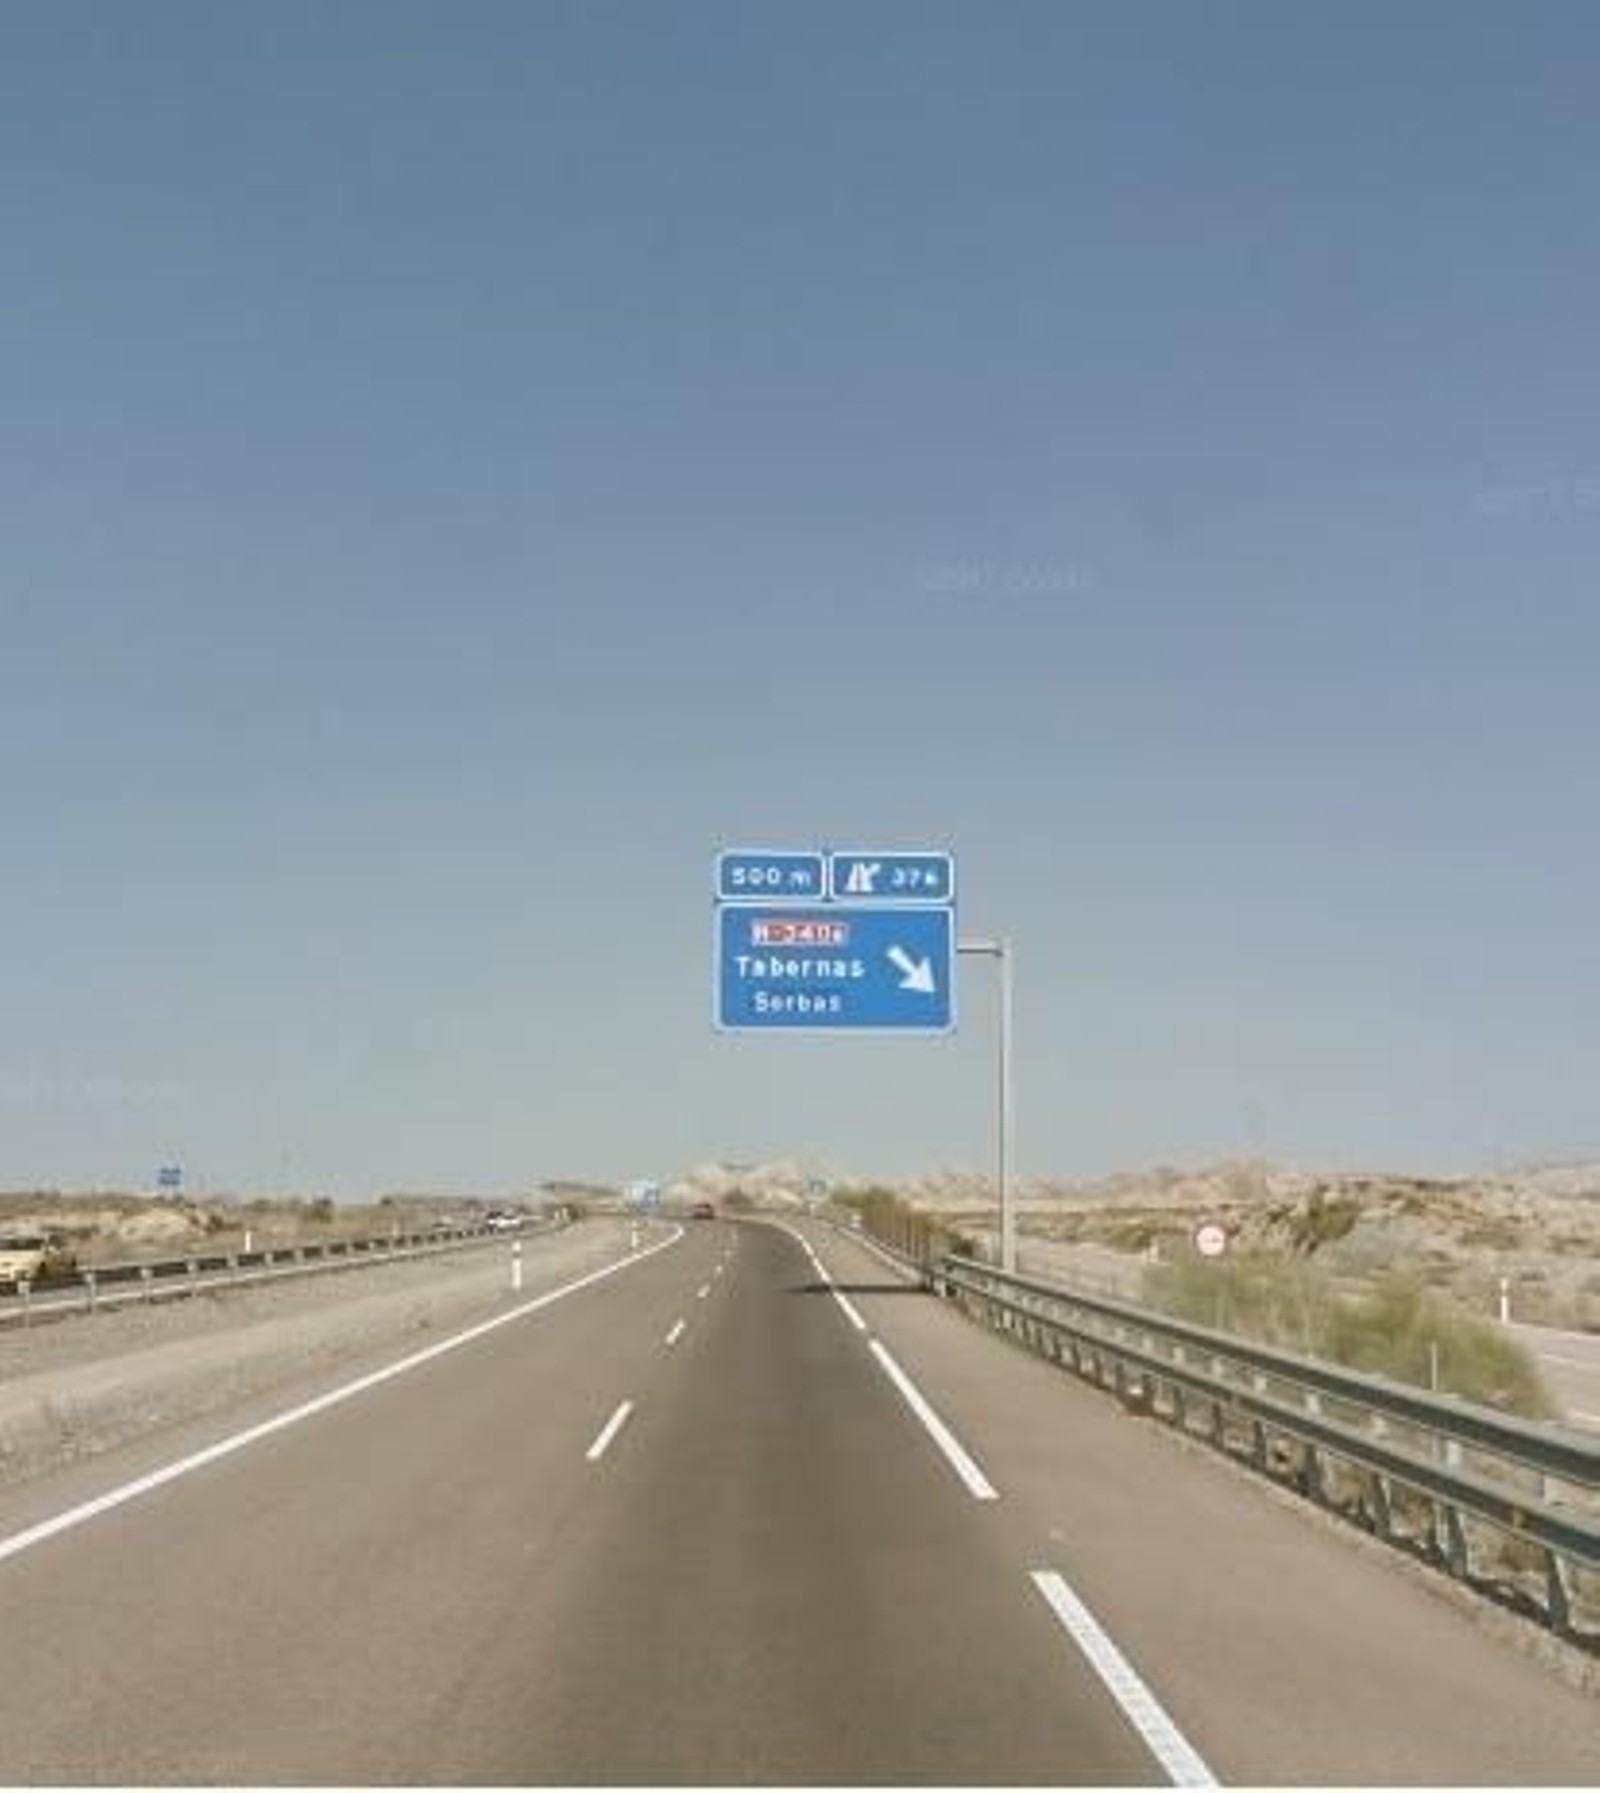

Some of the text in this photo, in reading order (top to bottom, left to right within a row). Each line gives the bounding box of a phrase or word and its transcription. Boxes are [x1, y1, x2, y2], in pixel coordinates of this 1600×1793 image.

[731, 867, 812, 886] 500 m
[735, 956, 865, 978] Tabernas
